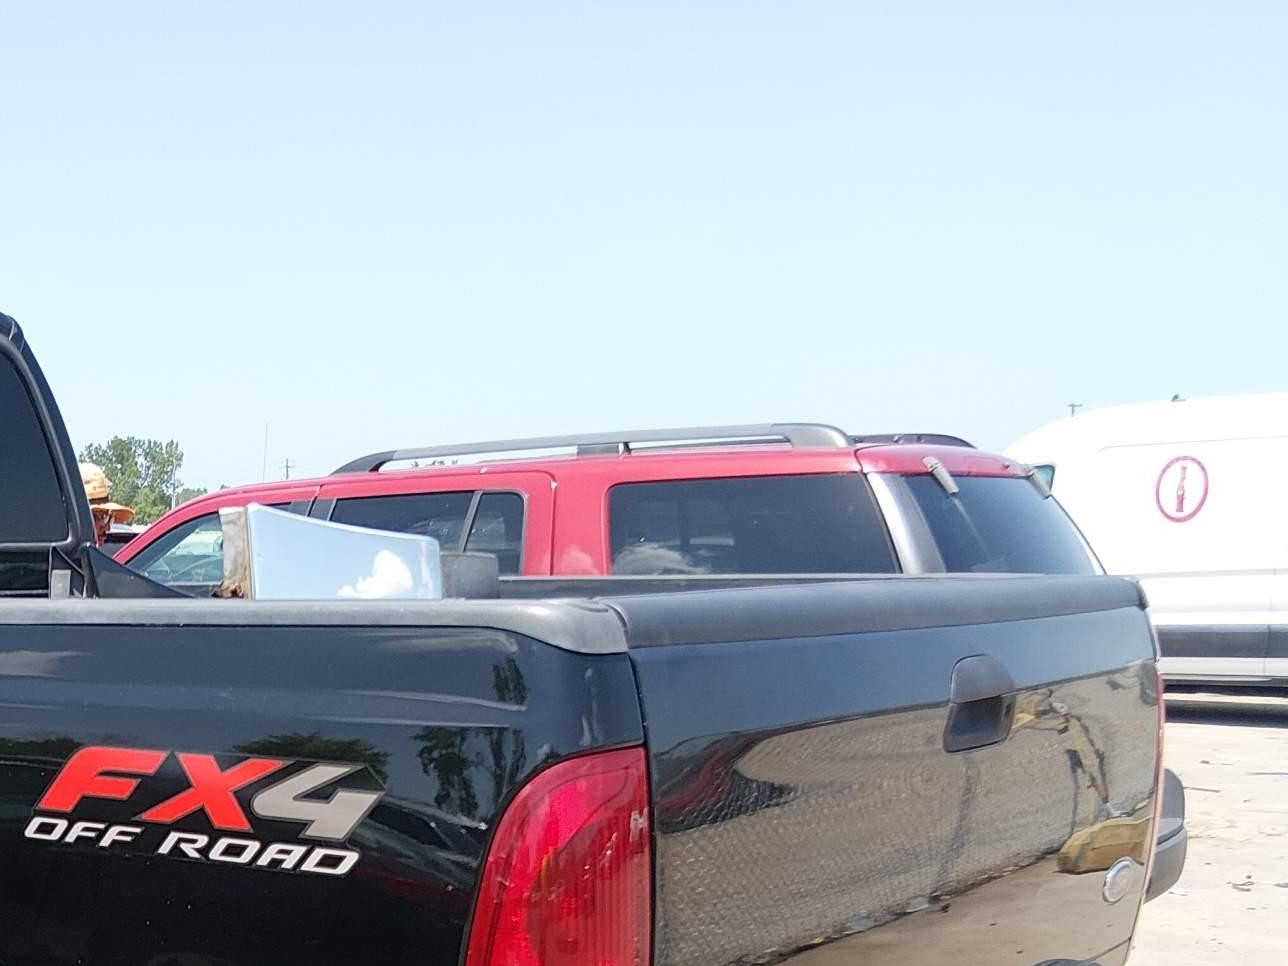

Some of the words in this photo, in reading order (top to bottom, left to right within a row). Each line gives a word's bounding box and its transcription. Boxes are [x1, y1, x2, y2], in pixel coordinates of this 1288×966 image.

[32, 745, 387, 841] FX4
[23, 816, 144, 848] OFF
[157, 831, 360, 877] ROAD
